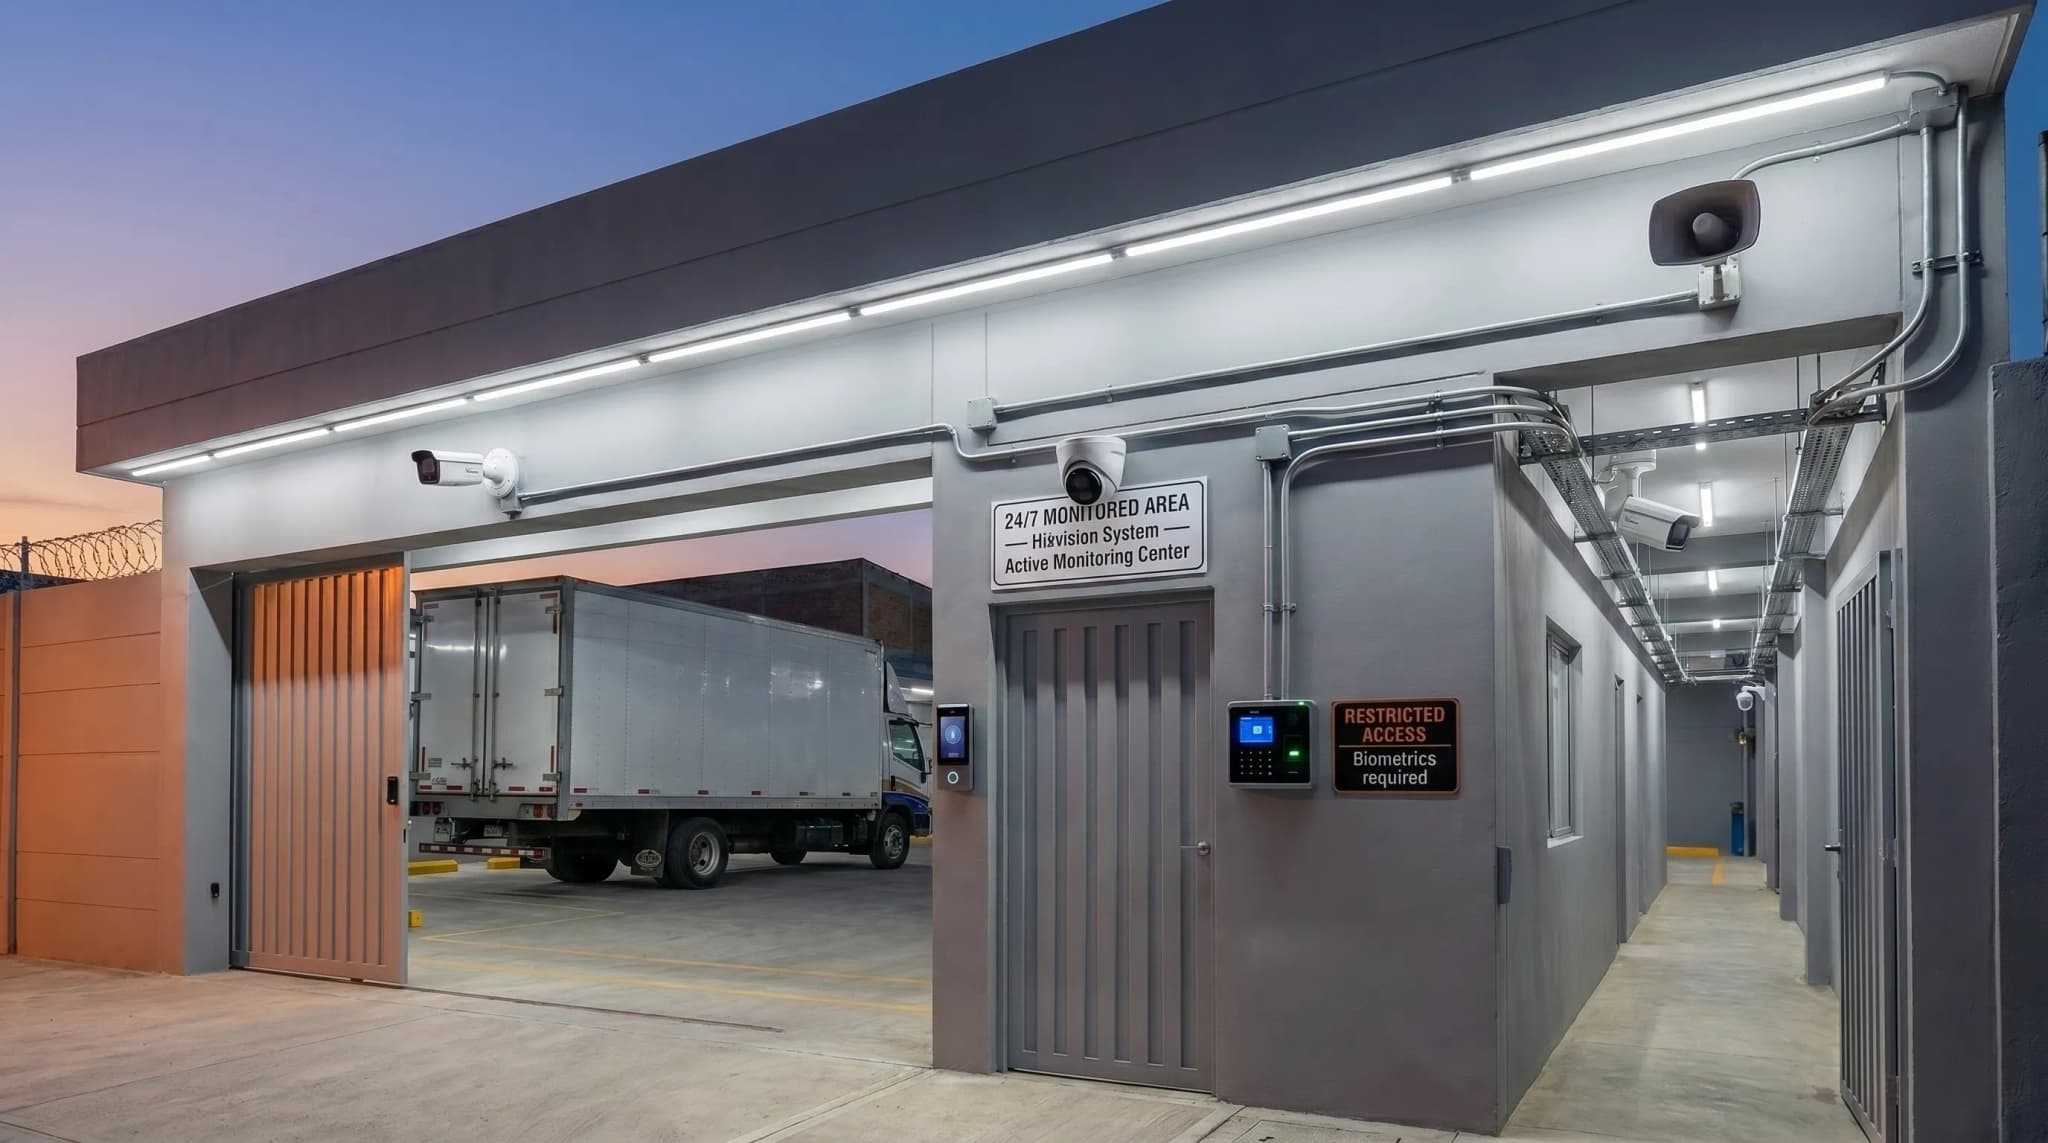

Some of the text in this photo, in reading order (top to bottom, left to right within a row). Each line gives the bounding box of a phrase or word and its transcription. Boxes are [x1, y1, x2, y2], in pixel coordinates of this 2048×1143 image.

[1005, 493, 1190, 530] 24/7 MONITORED AREA
[1103, 524, 1159, 545] System
[1005, 544, 1190, 574] Active Monitoring Center
[1345, 706, 1445, 724] RESTRICTED
[1362, 727, 1426, 743] ACCESS
[1353, 751, 1437, 767] Biometrics
[1362, 770, 1428, 789] required
